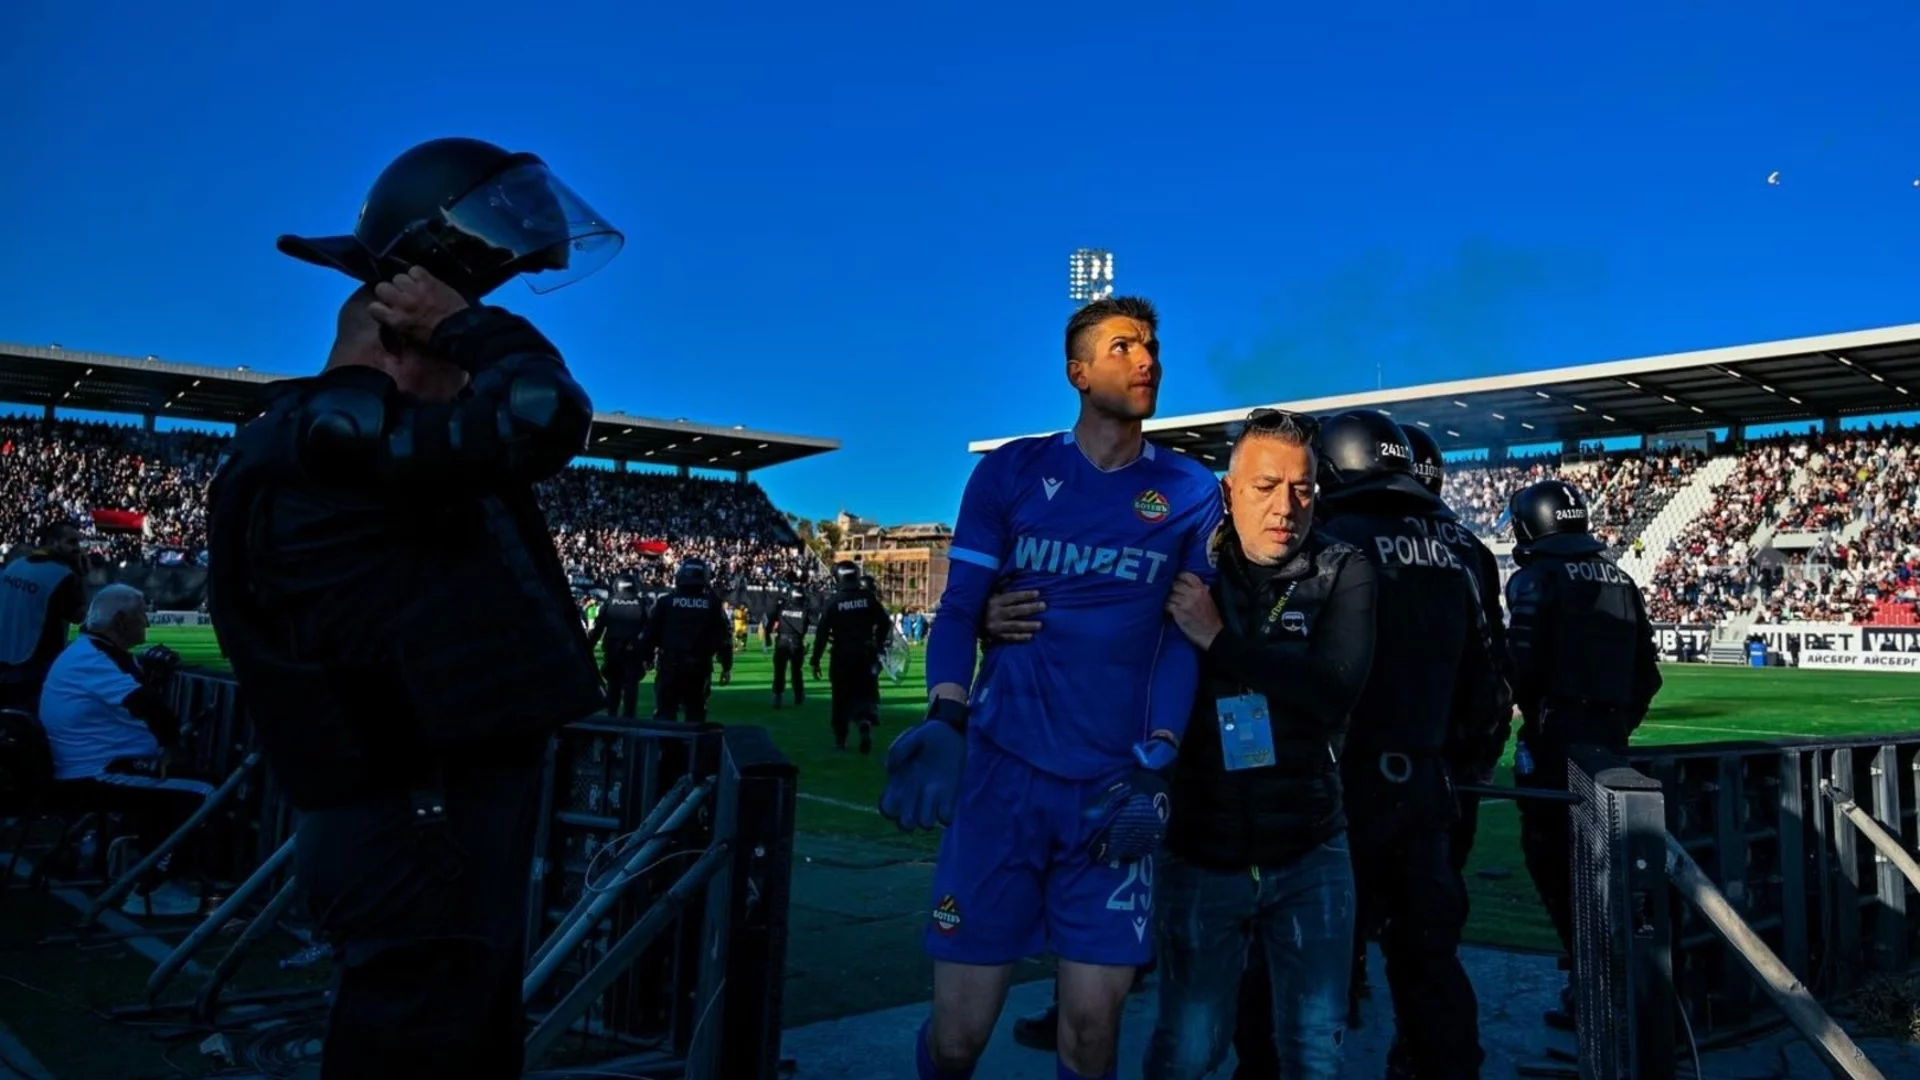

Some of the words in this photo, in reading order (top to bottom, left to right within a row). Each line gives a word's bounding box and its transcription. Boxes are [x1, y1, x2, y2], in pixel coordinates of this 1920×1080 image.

[1016, 536, 1168, 584] WINBET
[1374, 535, 1463, 571] POLICE
[1563, 561, 1631, 585] POLICE
[672, 597, 711, 609] POLICE
[837, 598, 869, 612] POLICE
[1807, 655, 1858, 664] АЙСБЕРГ
[1863, 656, 1917, 666] АЙСБЕРГ
[1106, 853, 1153, 912] 29
